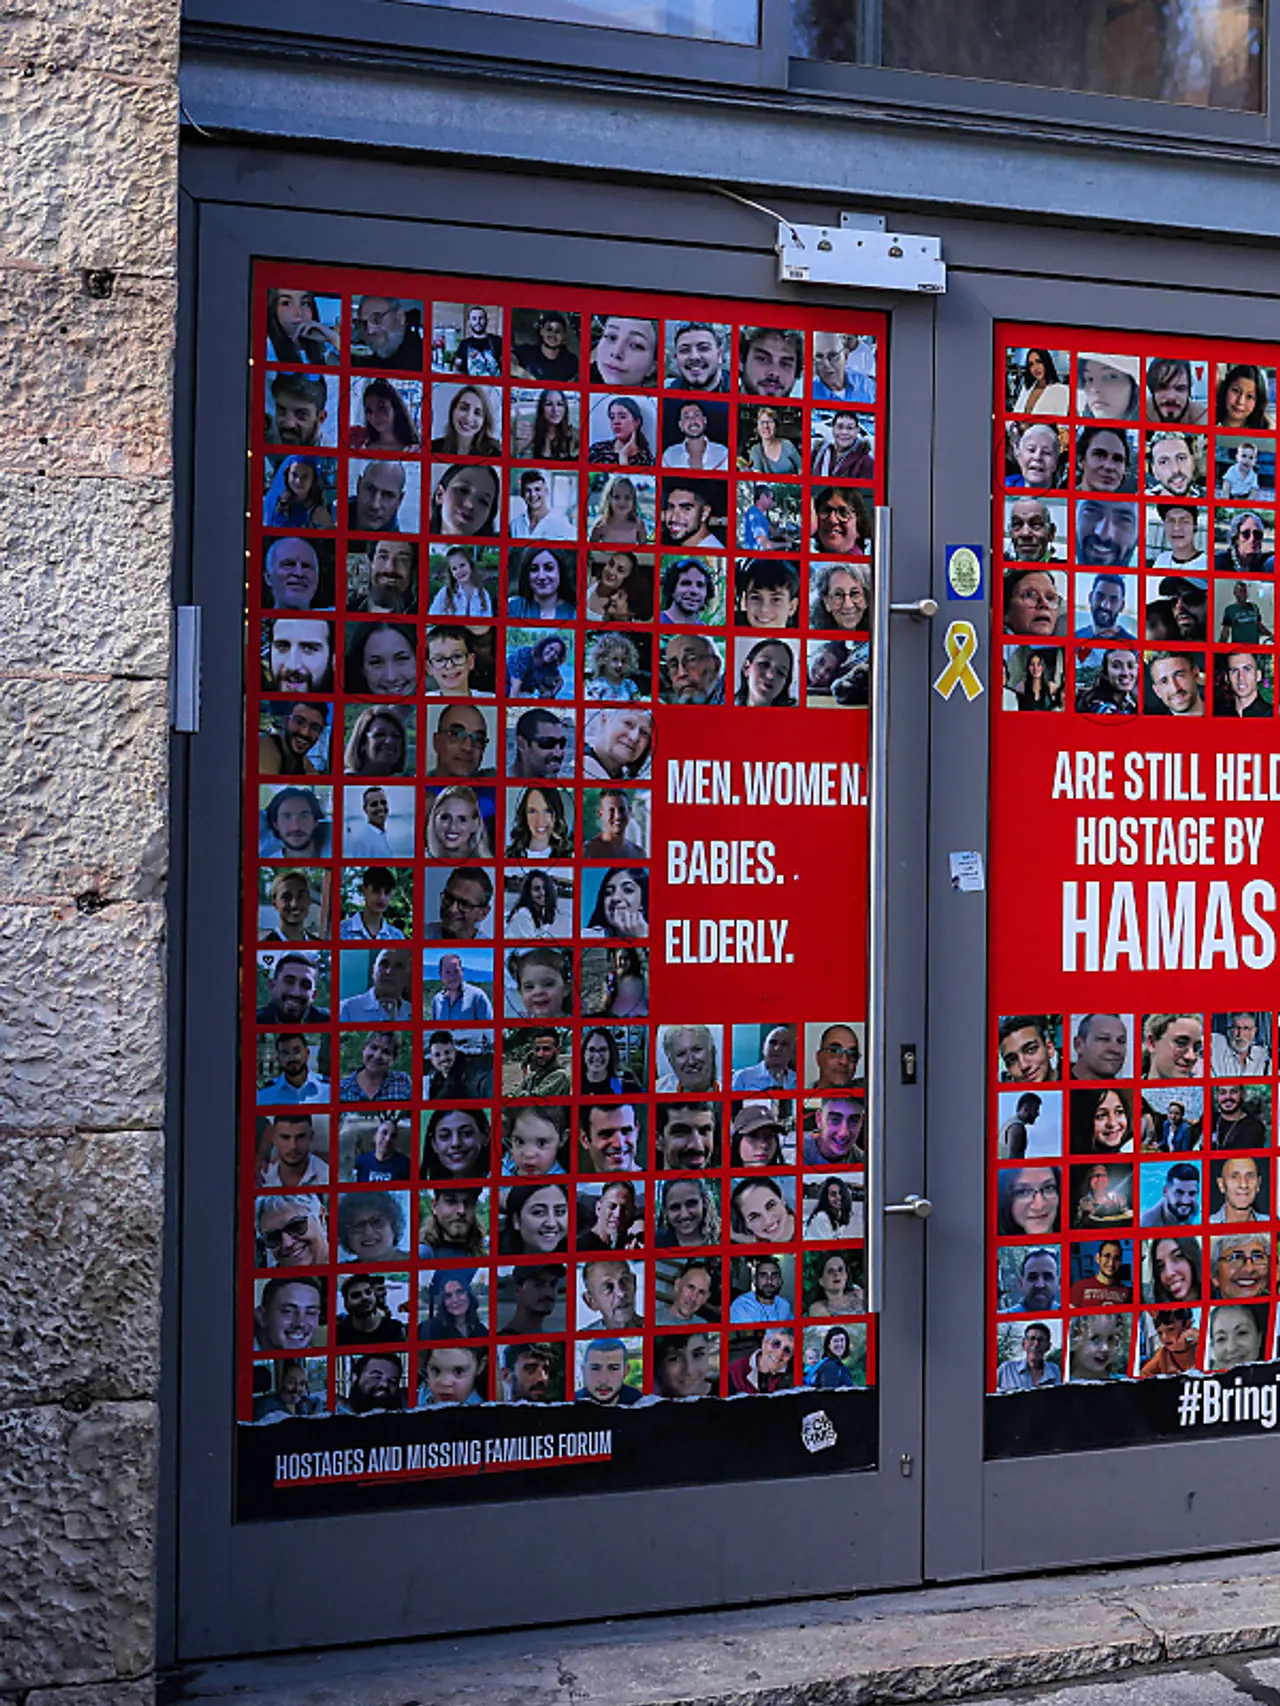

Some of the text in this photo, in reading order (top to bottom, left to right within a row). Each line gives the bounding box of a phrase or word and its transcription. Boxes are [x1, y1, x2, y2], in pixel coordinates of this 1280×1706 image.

[667, 760, 740, 805] MEN.
[1052, 751, 1115, 800] ARE
[1124, 751, 1206, 801] STILL
[667, 840, 785, 885] BABIES.
[1075, 816, 1264, 865] HOSTAGE BY
[665, 919, 795, 964] ELDERLY.
[1062, 879, 1277, 972] HAMAS
[275, 1430, 612, 1480] HOSTAGES AND MISSING FAMILIES FORUM
